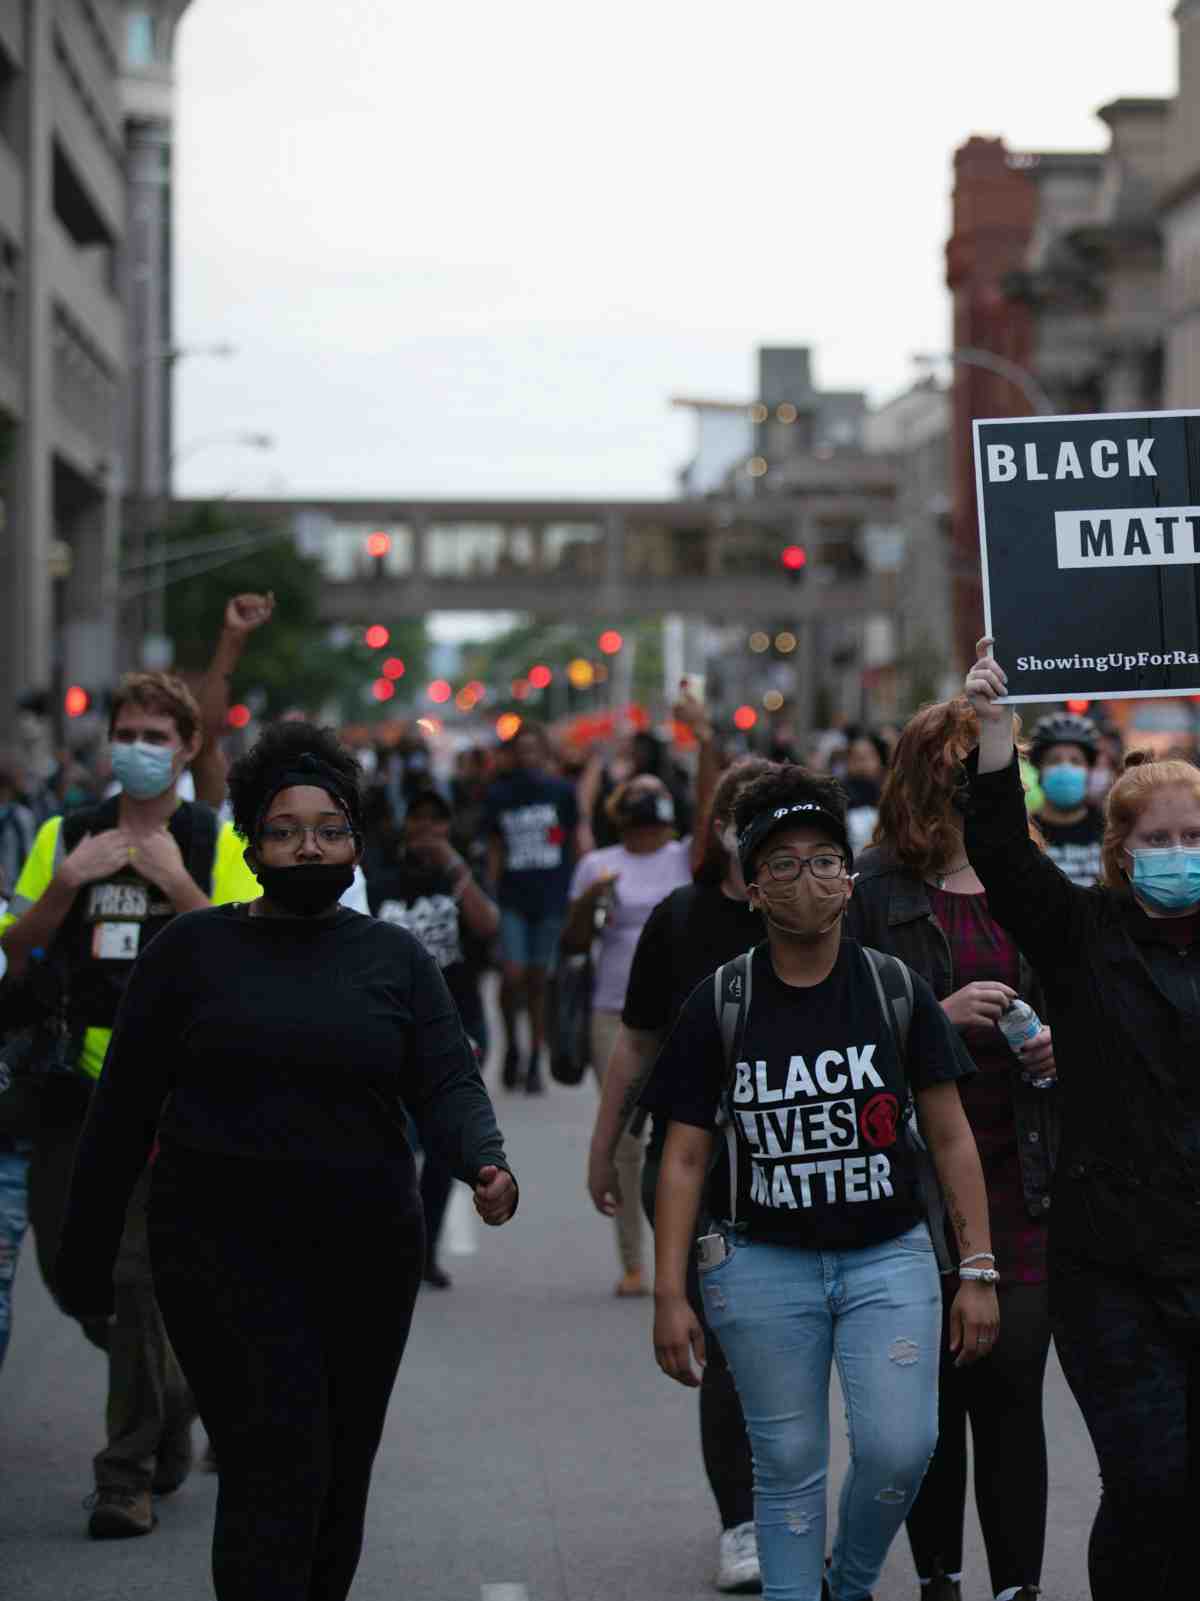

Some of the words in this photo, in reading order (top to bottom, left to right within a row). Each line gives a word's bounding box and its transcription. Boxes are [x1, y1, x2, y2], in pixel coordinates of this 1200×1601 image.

[986, 437, 1158, 483] BLACK
[733, 1044, 885, 1103] BLACK
[736, 1102, 856, 1156] LIVES
[750, 1152, 894, 1210] MATTER
